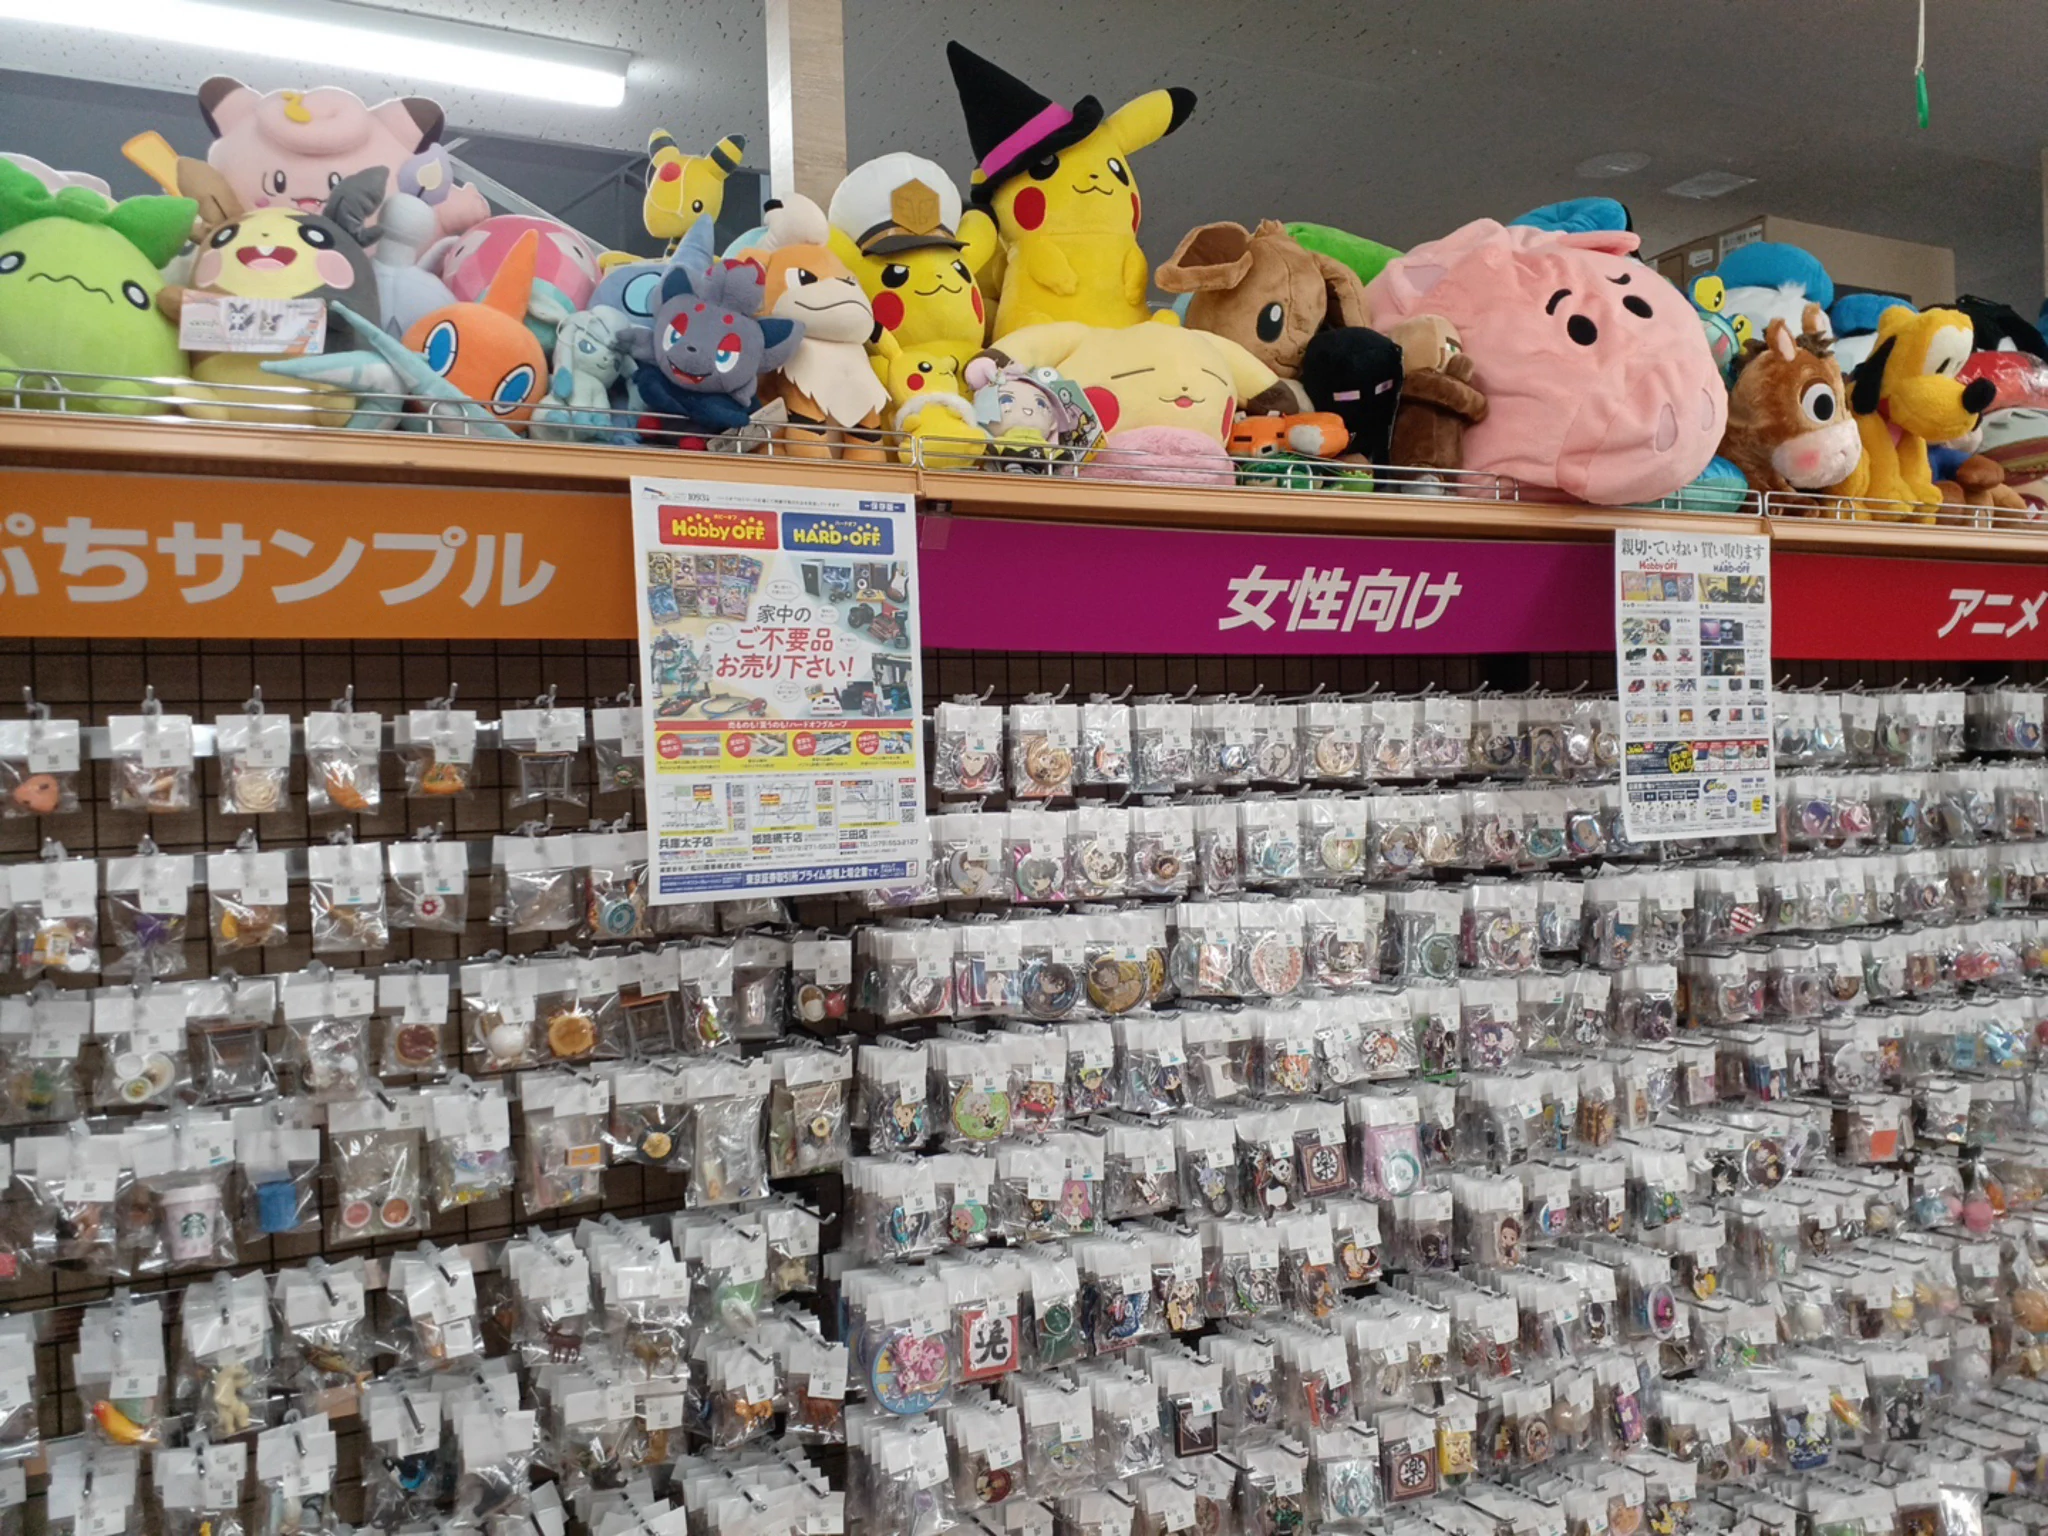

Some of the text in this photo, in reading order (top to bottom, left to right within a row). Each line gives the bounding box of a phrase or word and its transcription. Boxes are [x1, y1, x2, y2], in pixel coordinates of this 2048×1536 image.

[672, 518, 766, 541] Hobby OFF
[1639, 560, 1664, 570] Hobby
[1218, 565, 1463, 632] 女性向け
[757, 604, 811, 623] 家中の
[1937, 588, 2048, 639] アニメ
[736, 625, 834, 652] ご不要品
[716, 653, 854, 679] お売り下さい！
[839, 829, 868, 840] 三田店
[1316, 1151, 1336, 1179] 楽
